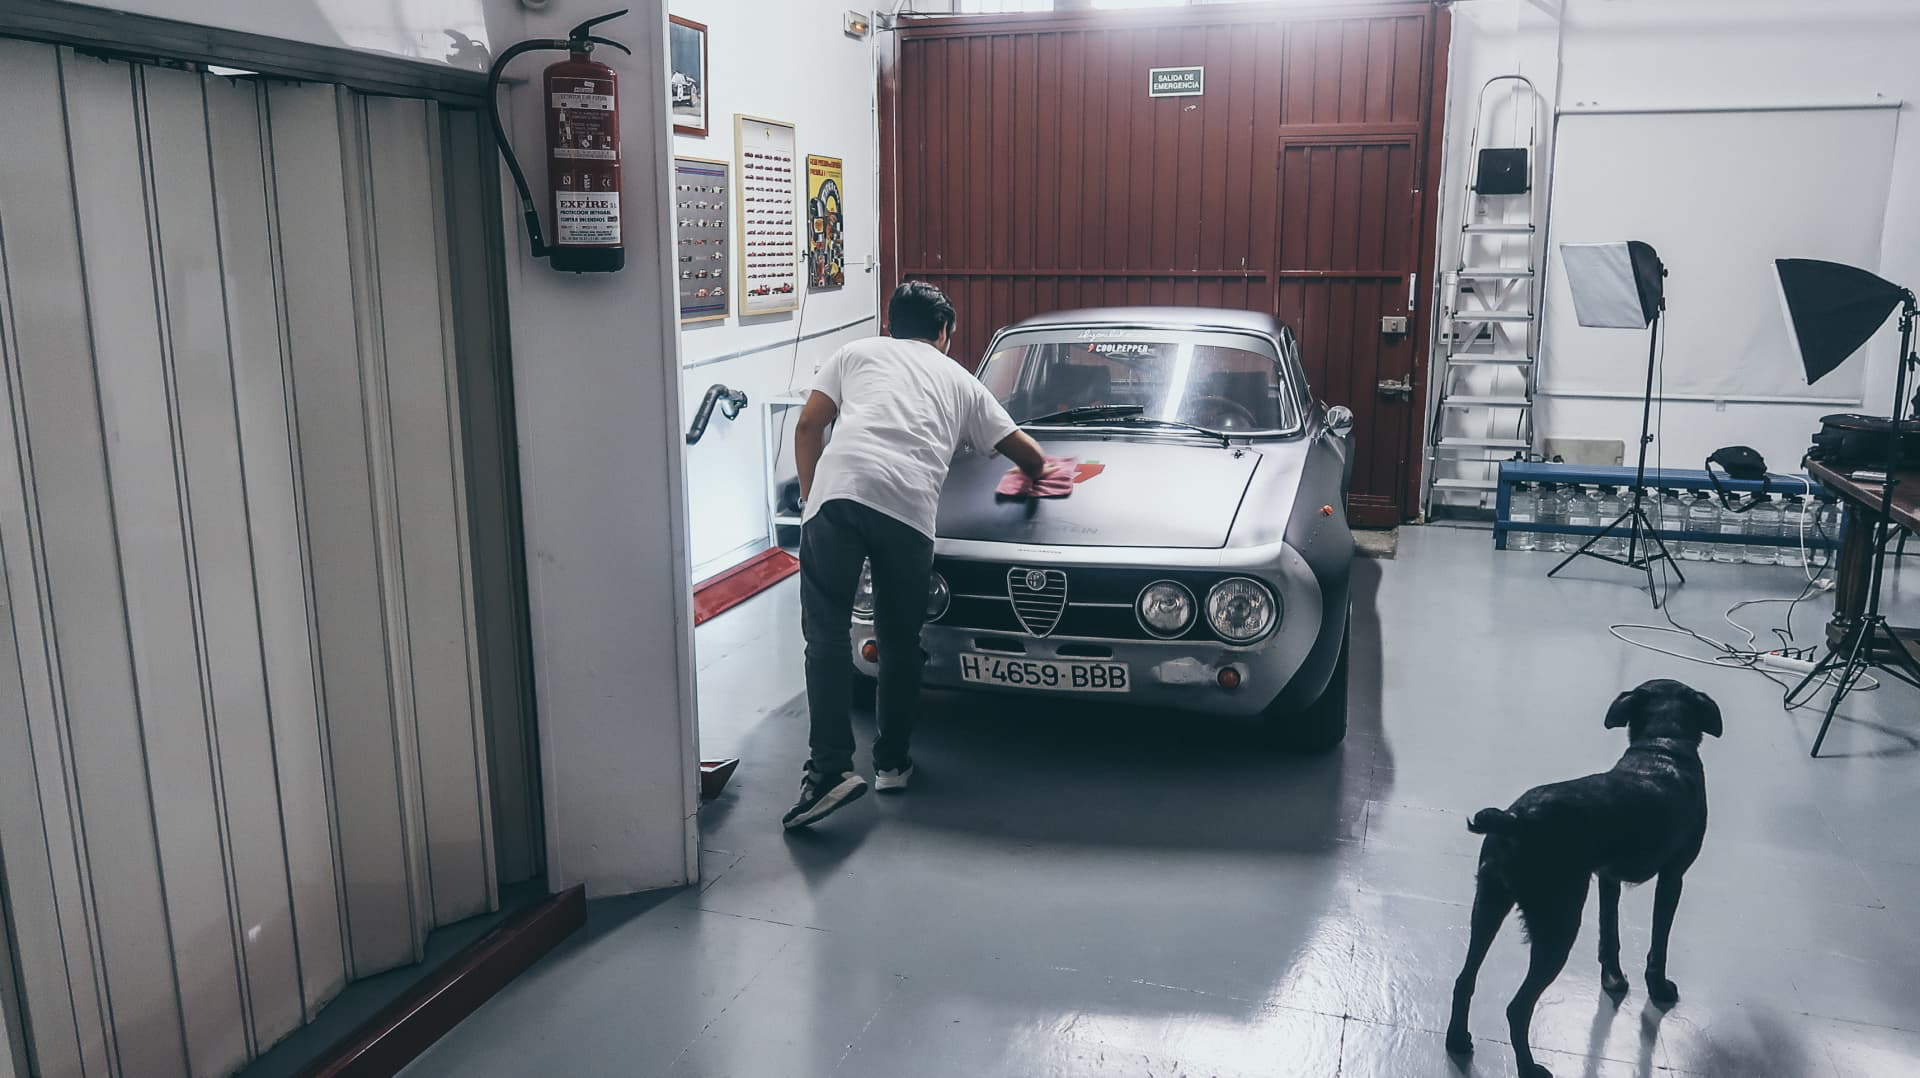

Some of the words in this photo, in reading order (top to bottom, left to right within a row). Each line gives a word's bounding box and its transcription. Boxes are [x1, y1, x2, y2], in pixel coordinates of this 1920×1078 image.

[1154, 81, 1200, 90] EMERGENCIA
[560, 199, 609, 209] EXFIRE
[1095, 344, 1149, 353] COOLPEPPER
